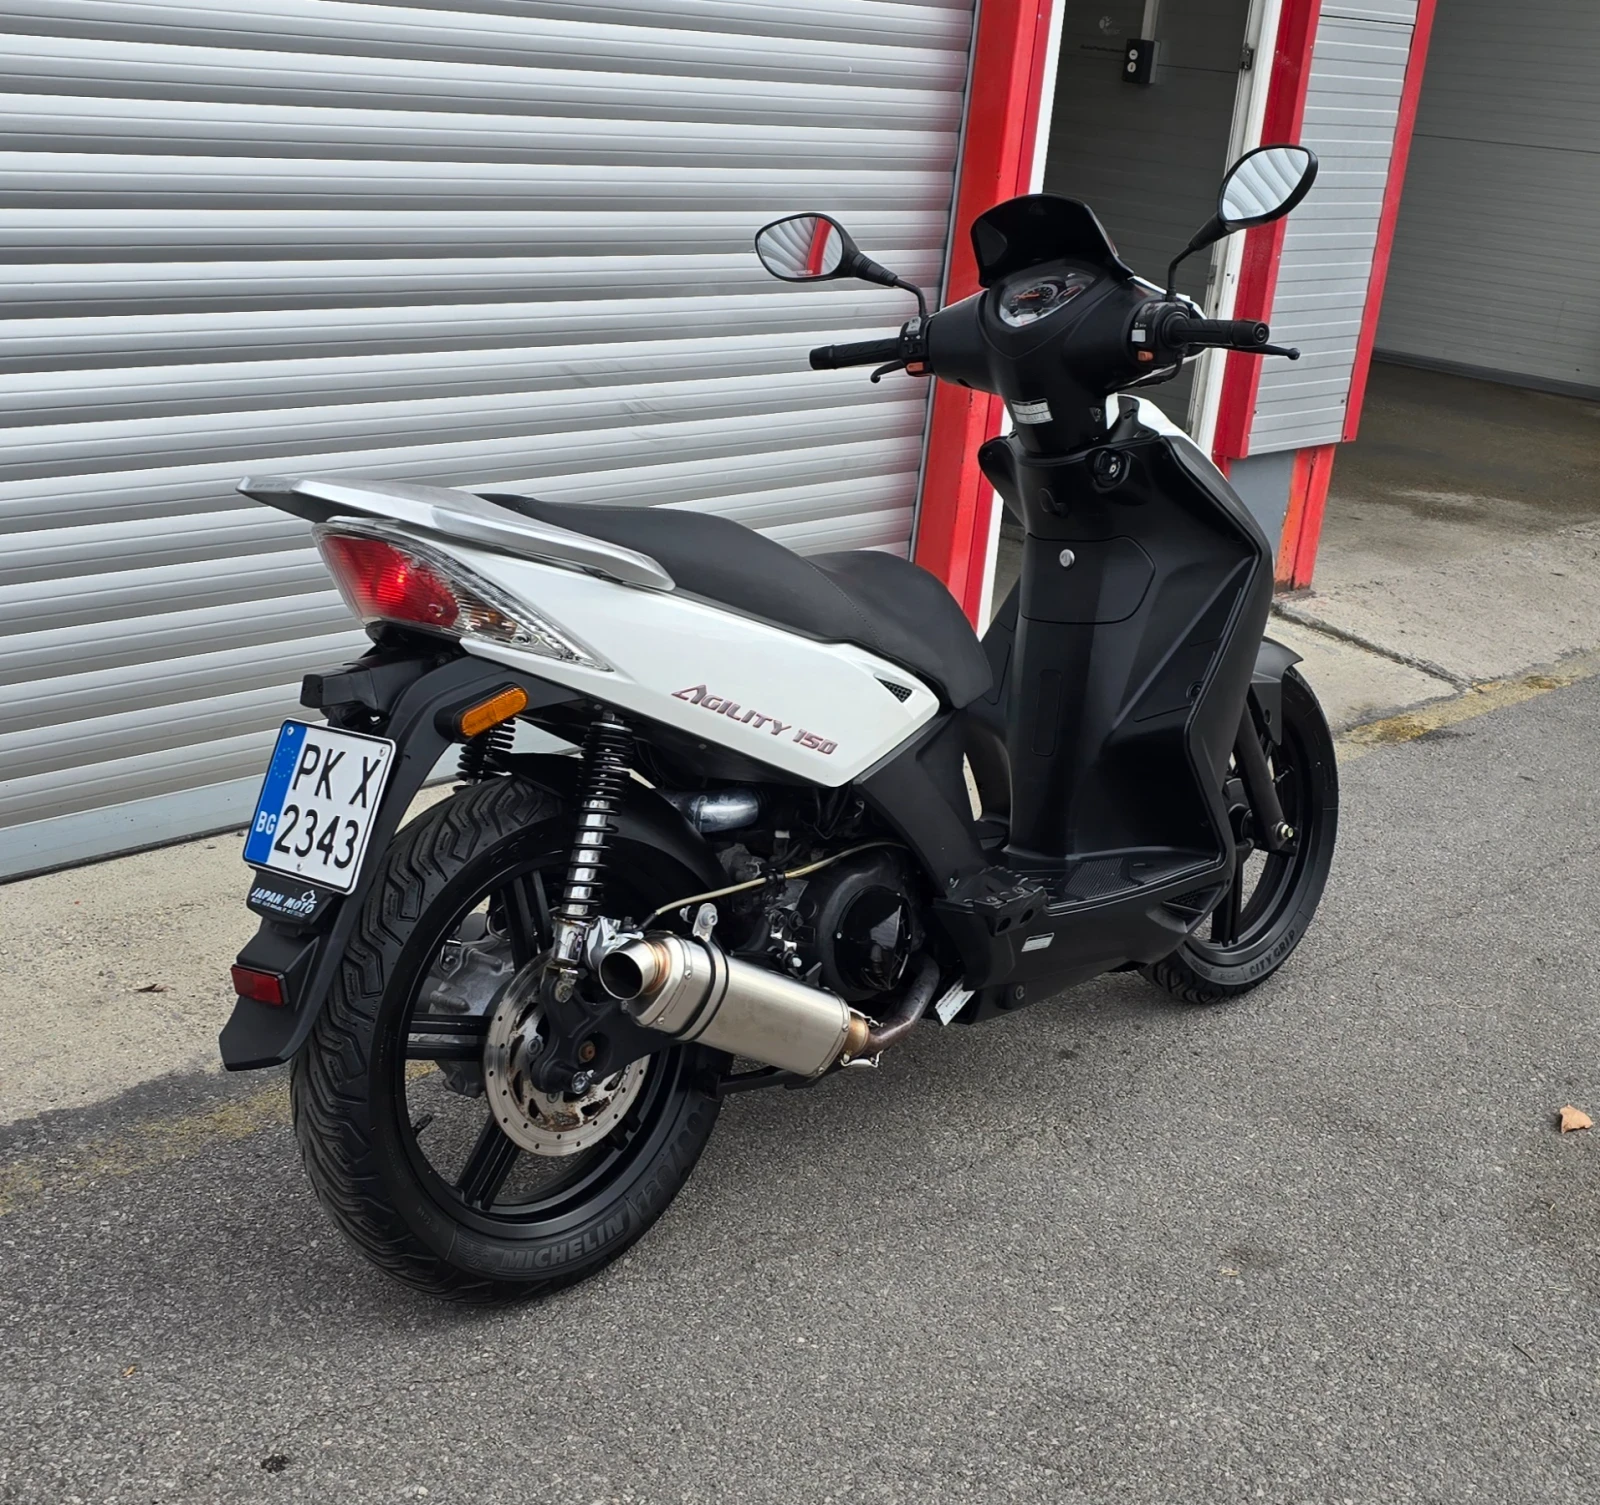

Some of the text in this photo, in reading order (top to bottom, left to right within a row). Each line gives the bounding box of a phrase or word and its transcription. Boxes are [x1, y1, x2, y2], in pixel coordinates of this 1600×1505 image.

[671, 684, 838, 755] AGILITY 150
[292, 743, 381, 809] PK X
[255, 810, 277, 835] BG
[274, 804, 359, 869] 2343
[251, 887, 284, 905] JAPAN
[284, 897, 314, 914] MOTO
[1250, 953, 1273, 976] CITY
[1273, 929, 1295, 958] GRIP
[500, 1212, 626, 1269] MICHELIN
